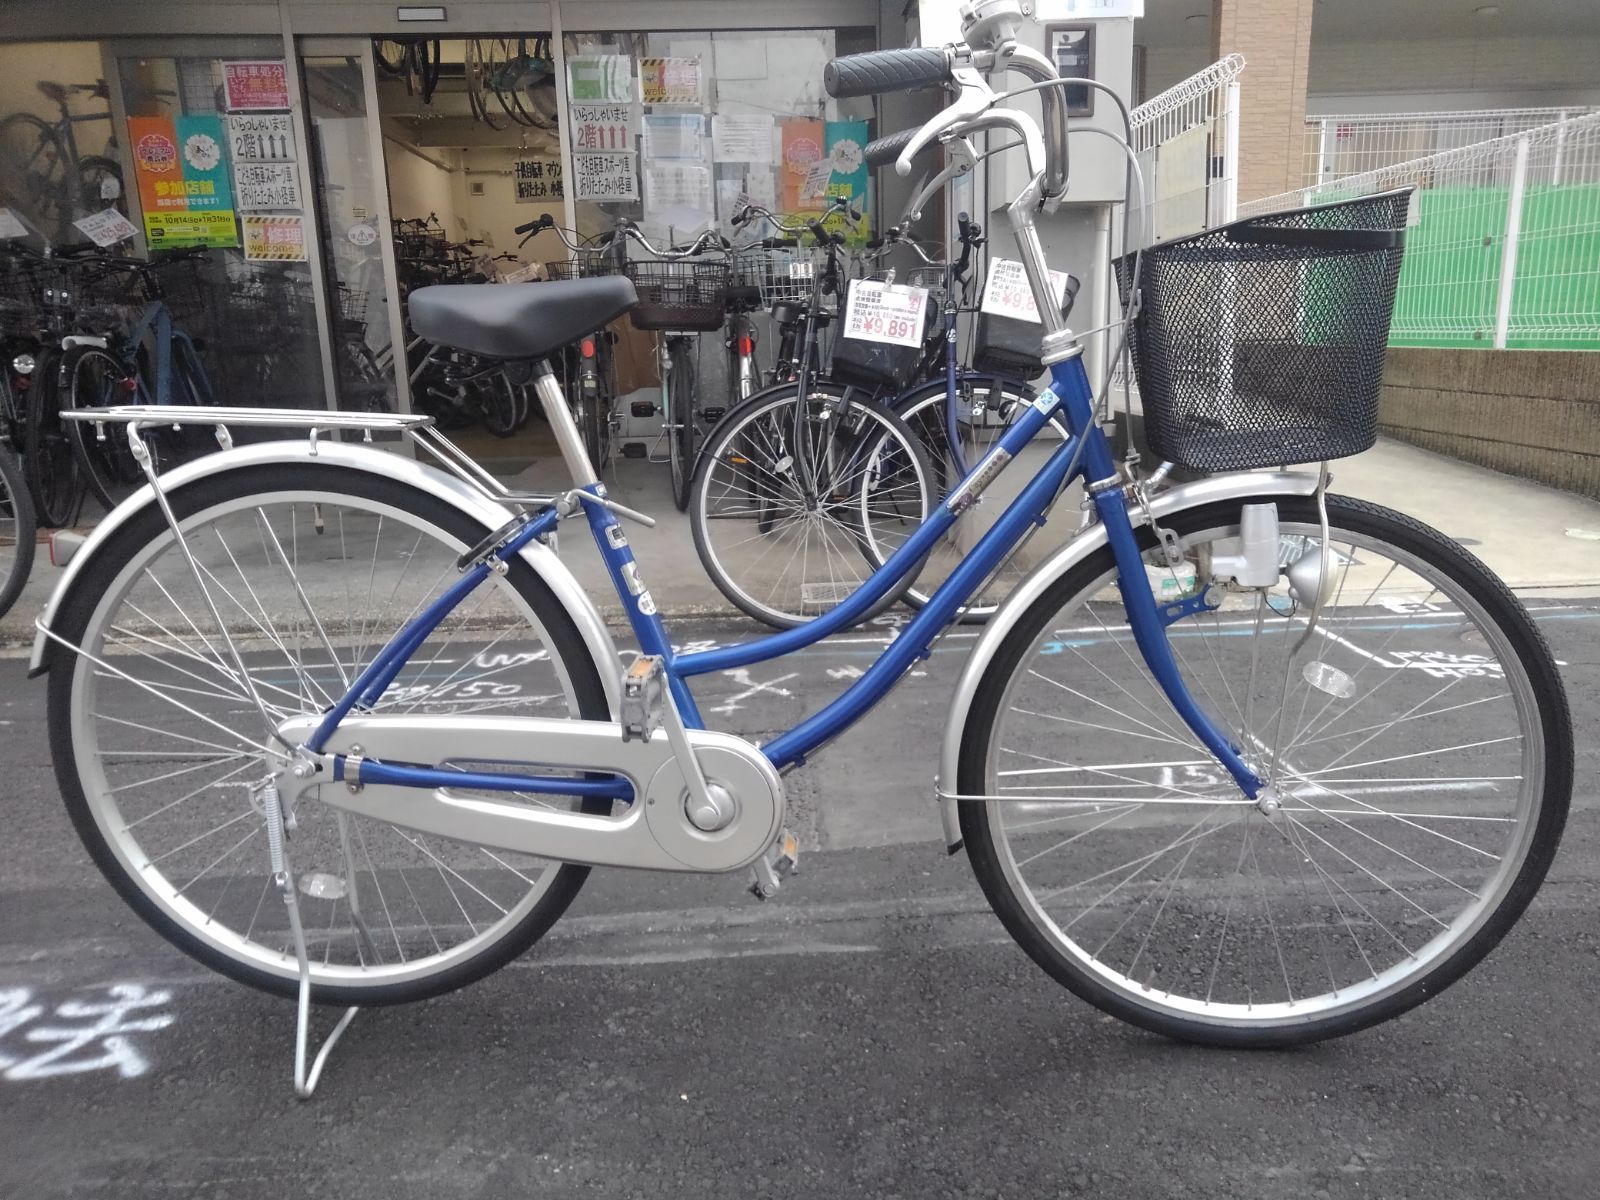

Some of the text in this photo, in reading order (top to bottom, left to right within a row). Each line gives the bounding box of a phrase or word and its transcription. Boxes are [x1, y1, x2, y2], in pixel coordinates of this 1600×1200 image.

[225, 65, 284, 78] 自転車処分
[575, 107, 628, 122] いらっしゃいませ
[231, 117, 287, 131] いらっしゃいませ
[577, 123, 597, 149] 2階
[235, 133, 257, 158] 2階
[154, 180, 215, 196] 参加店舗
[863, 316, 917, 339] ¥9,891
